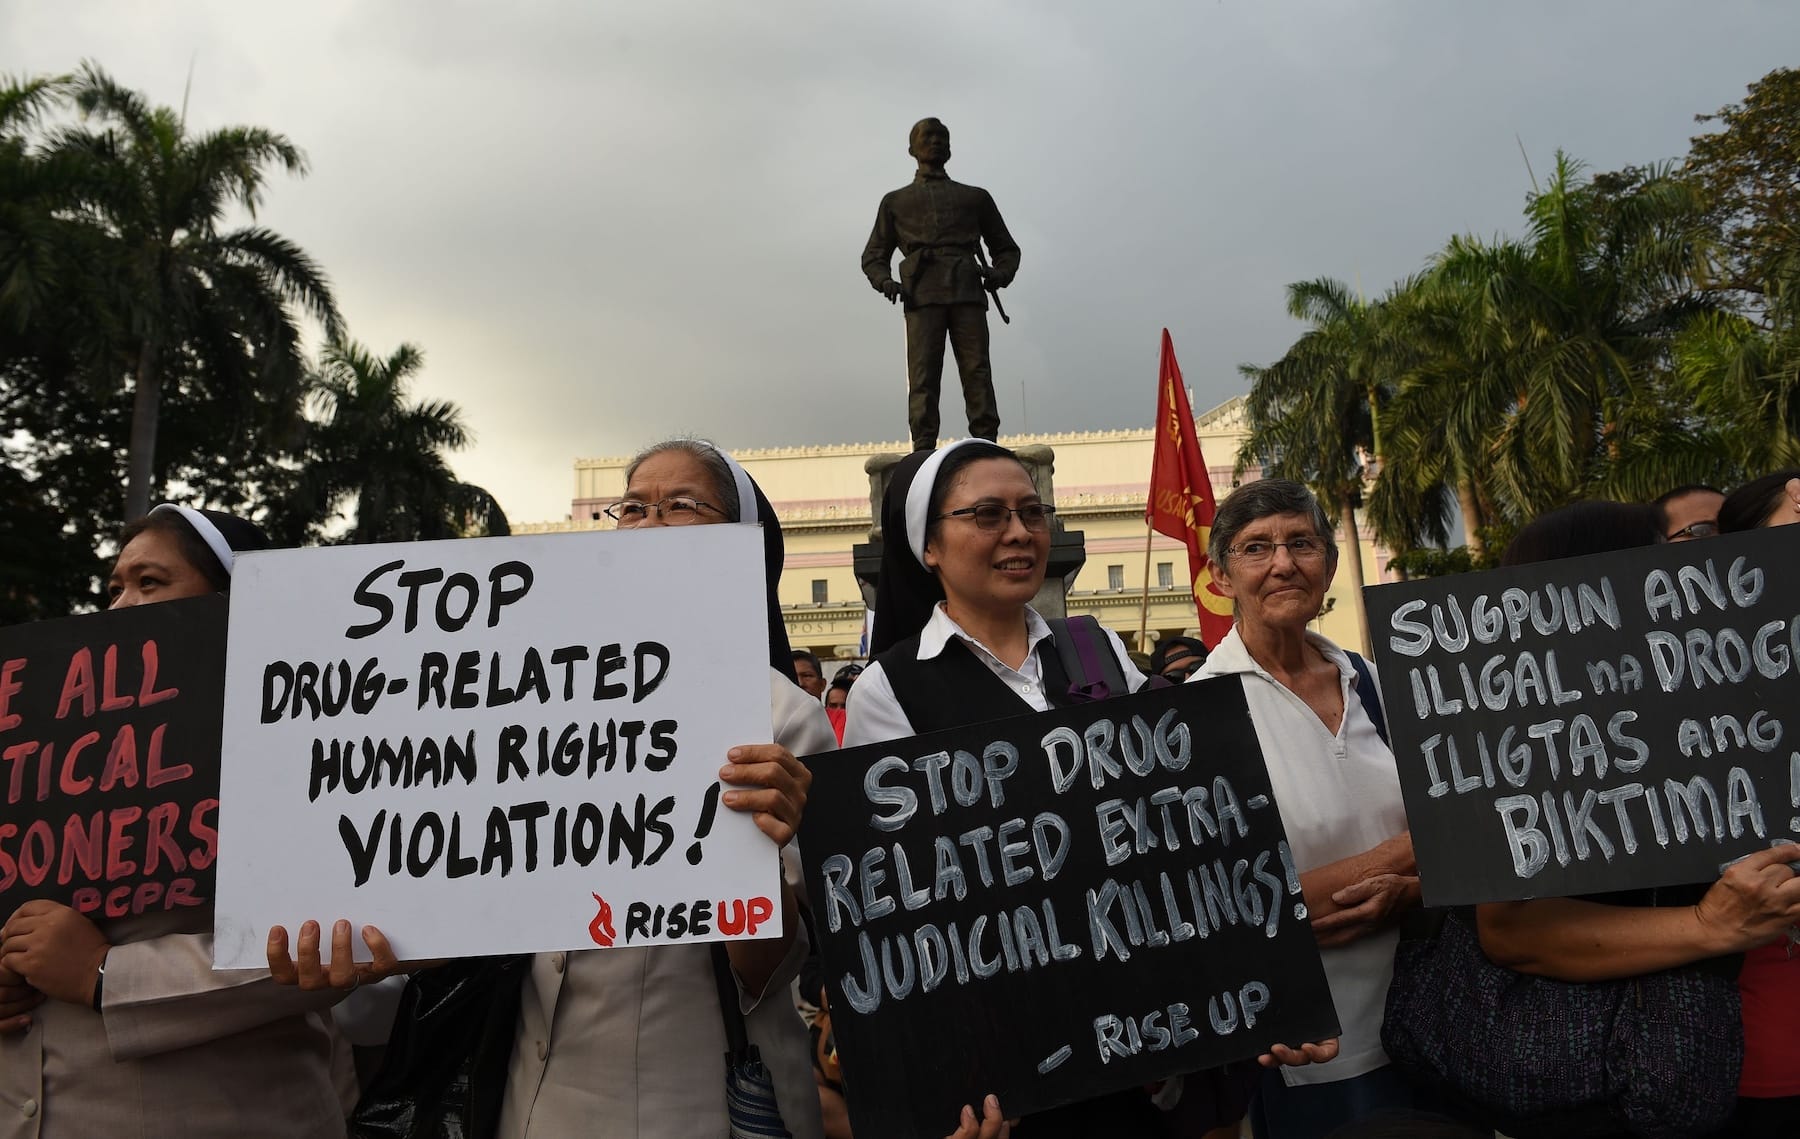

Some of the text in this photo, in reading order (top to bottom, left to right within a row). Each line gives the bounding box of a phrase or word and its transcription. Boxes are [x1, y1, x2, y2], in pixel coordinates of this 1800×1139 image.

[345, 559, 534, 639] STOP
[790, 621, 837, 634] POST
[1389, 555, 1765, 658] SUGPUIN ANG
[56, 639, 179, 719] ALL
[260, 641, 671, 725] DRUG-RELATED
[1408, 648, 1582, 720] ILIGAL
[2, 723, 194, 804] TICAL
[308, 718, 679, 803] HUMAN RIGHTS
[863, 708, 1192, 833] STOP DRUG
[1420, 710, 1650, 799] ILIGTAS
[0, 798, 218, 893] SONERS
[338, 782, 720, 888] VIOLATIONS!
[821, 775, 1270, 934] RELATED EXTRA-
[72, 878, 206, 919] PCPR
[841, 841, 1309, 1014] JUDICIAL KILLINGS!
[1093, 1002, 1199, 1064] RISE
[1208, 981, 1271, 1036] UP
